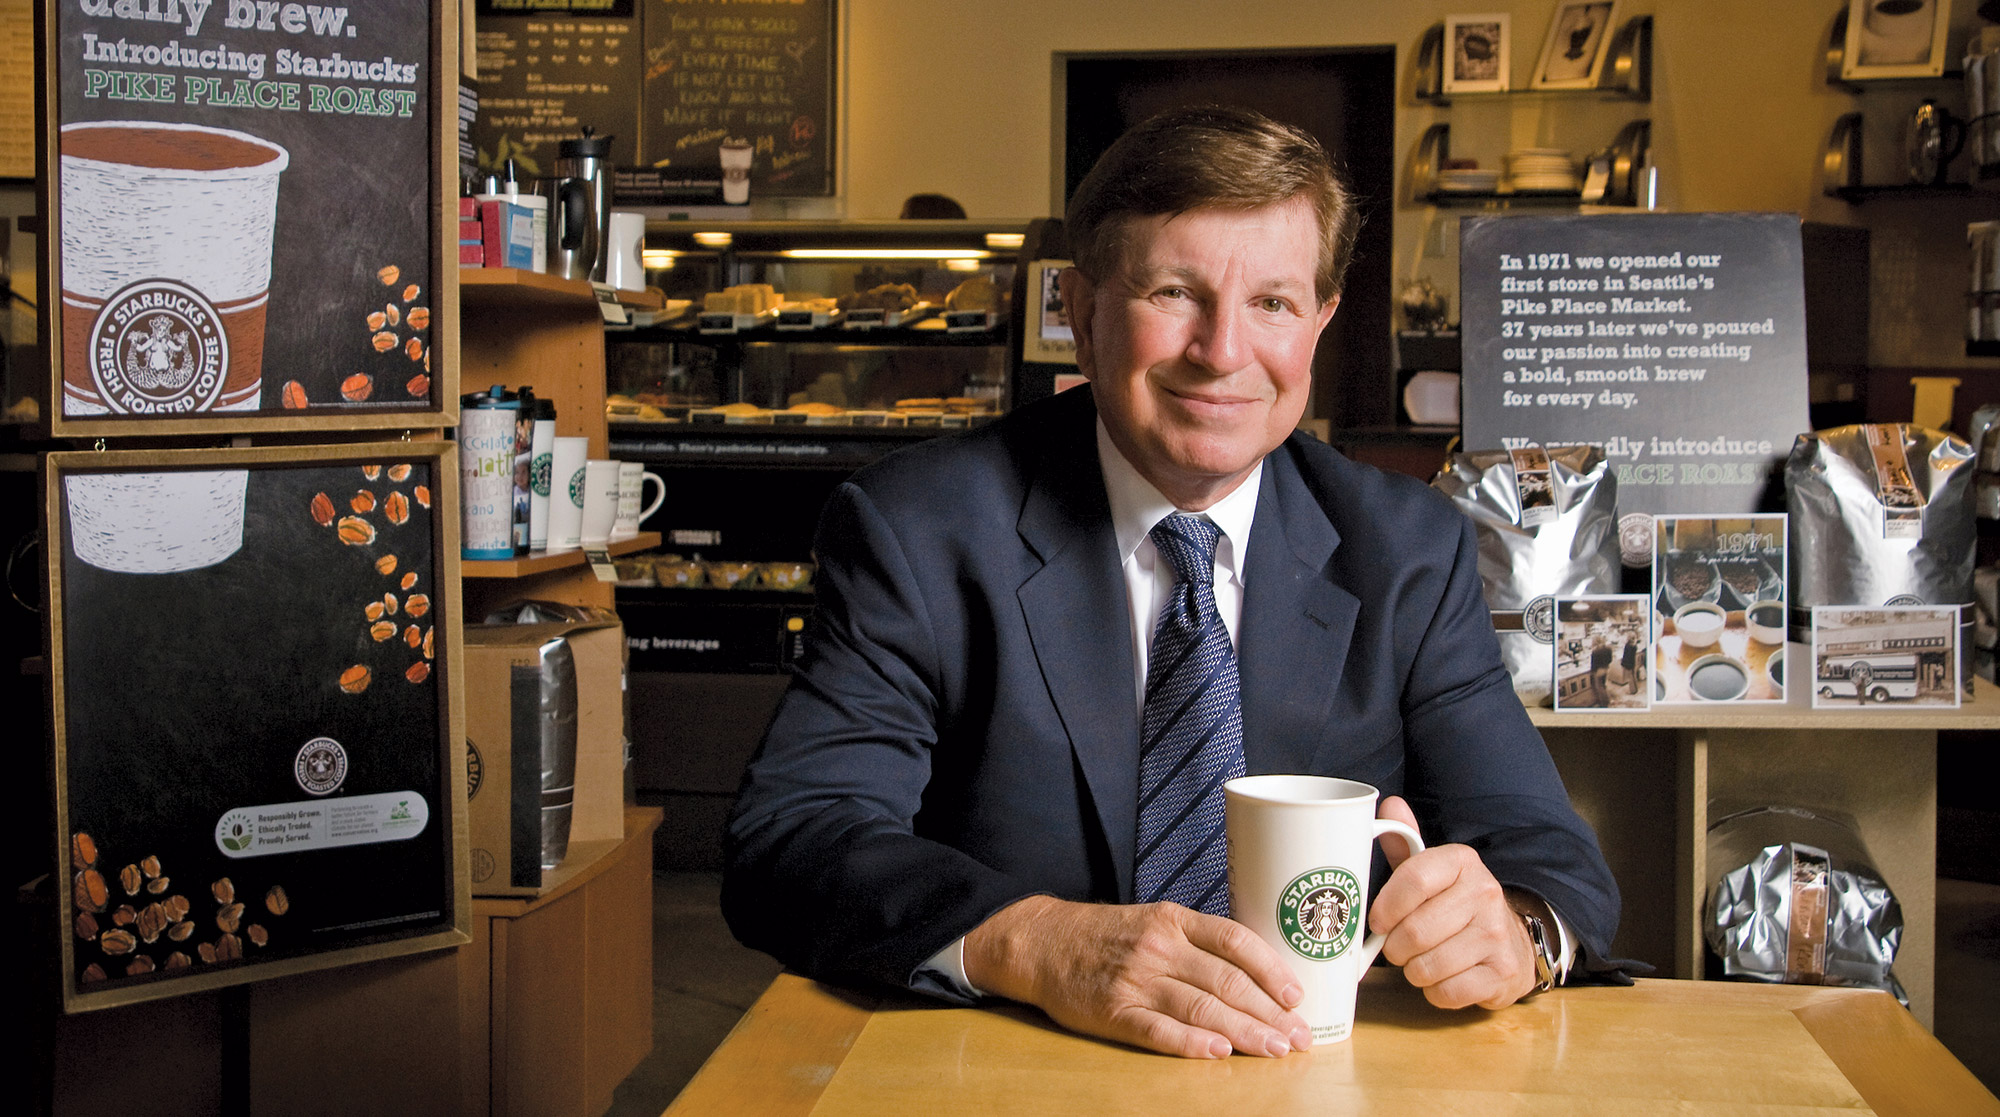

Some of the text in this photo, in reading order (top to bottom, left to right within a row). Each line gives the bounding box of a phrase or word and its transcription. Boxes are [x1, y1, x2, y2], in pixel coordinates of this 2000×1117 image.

[225, 0, 356, 37] brew.
[83, 34, 416, 83] Introducing Starbucks
[682, 52, 729, 68] EVERY
[727, 74, 757, 89] LET
[84, 69, 416, 117] PIKE PLACE ROAST
[664, 106, 709, 125] MAKE
[1500, 252, 1721, 273] In 1971 we opened our
[1501, 274, 1715, 293] first store in Seattle's
[113, 292, 206, 326] STARBUCKS
[1501, 297, 1692, 316] Pike Place Market.
[1501, 318, 1775, 341] 37 years later we've poured
[1502, 343, 1751, 364] our passion into creating
[100, 336, 124, 394] FRESH
[194, 336, 219, 398] COFFEE
[1503, 365, 1706, 386] a bold, smooth brew
[120, 390, 196, 413] ROASTED
[1502, 389, 1639, 409] for every day.
[1651, 436, 1773, 456] introduce
[1617, 464, 1674, 485] ACE
[1717, 533, 1776, 554] 1971
[652, 636, 720, 653] beverages
[304, 741, 339, 756] STARBUCKS
[258, 811, 297, 823] Responsibly
[298, 810, 322, 818] Grown.
[258, 821, 313, 834] Ethically Traded.
[258, 833, 311, 846] Proudly Served.
[1284, 871, 1360, 910] STARBUCKS
[1290, 931, 1351, 957] COFFEE
